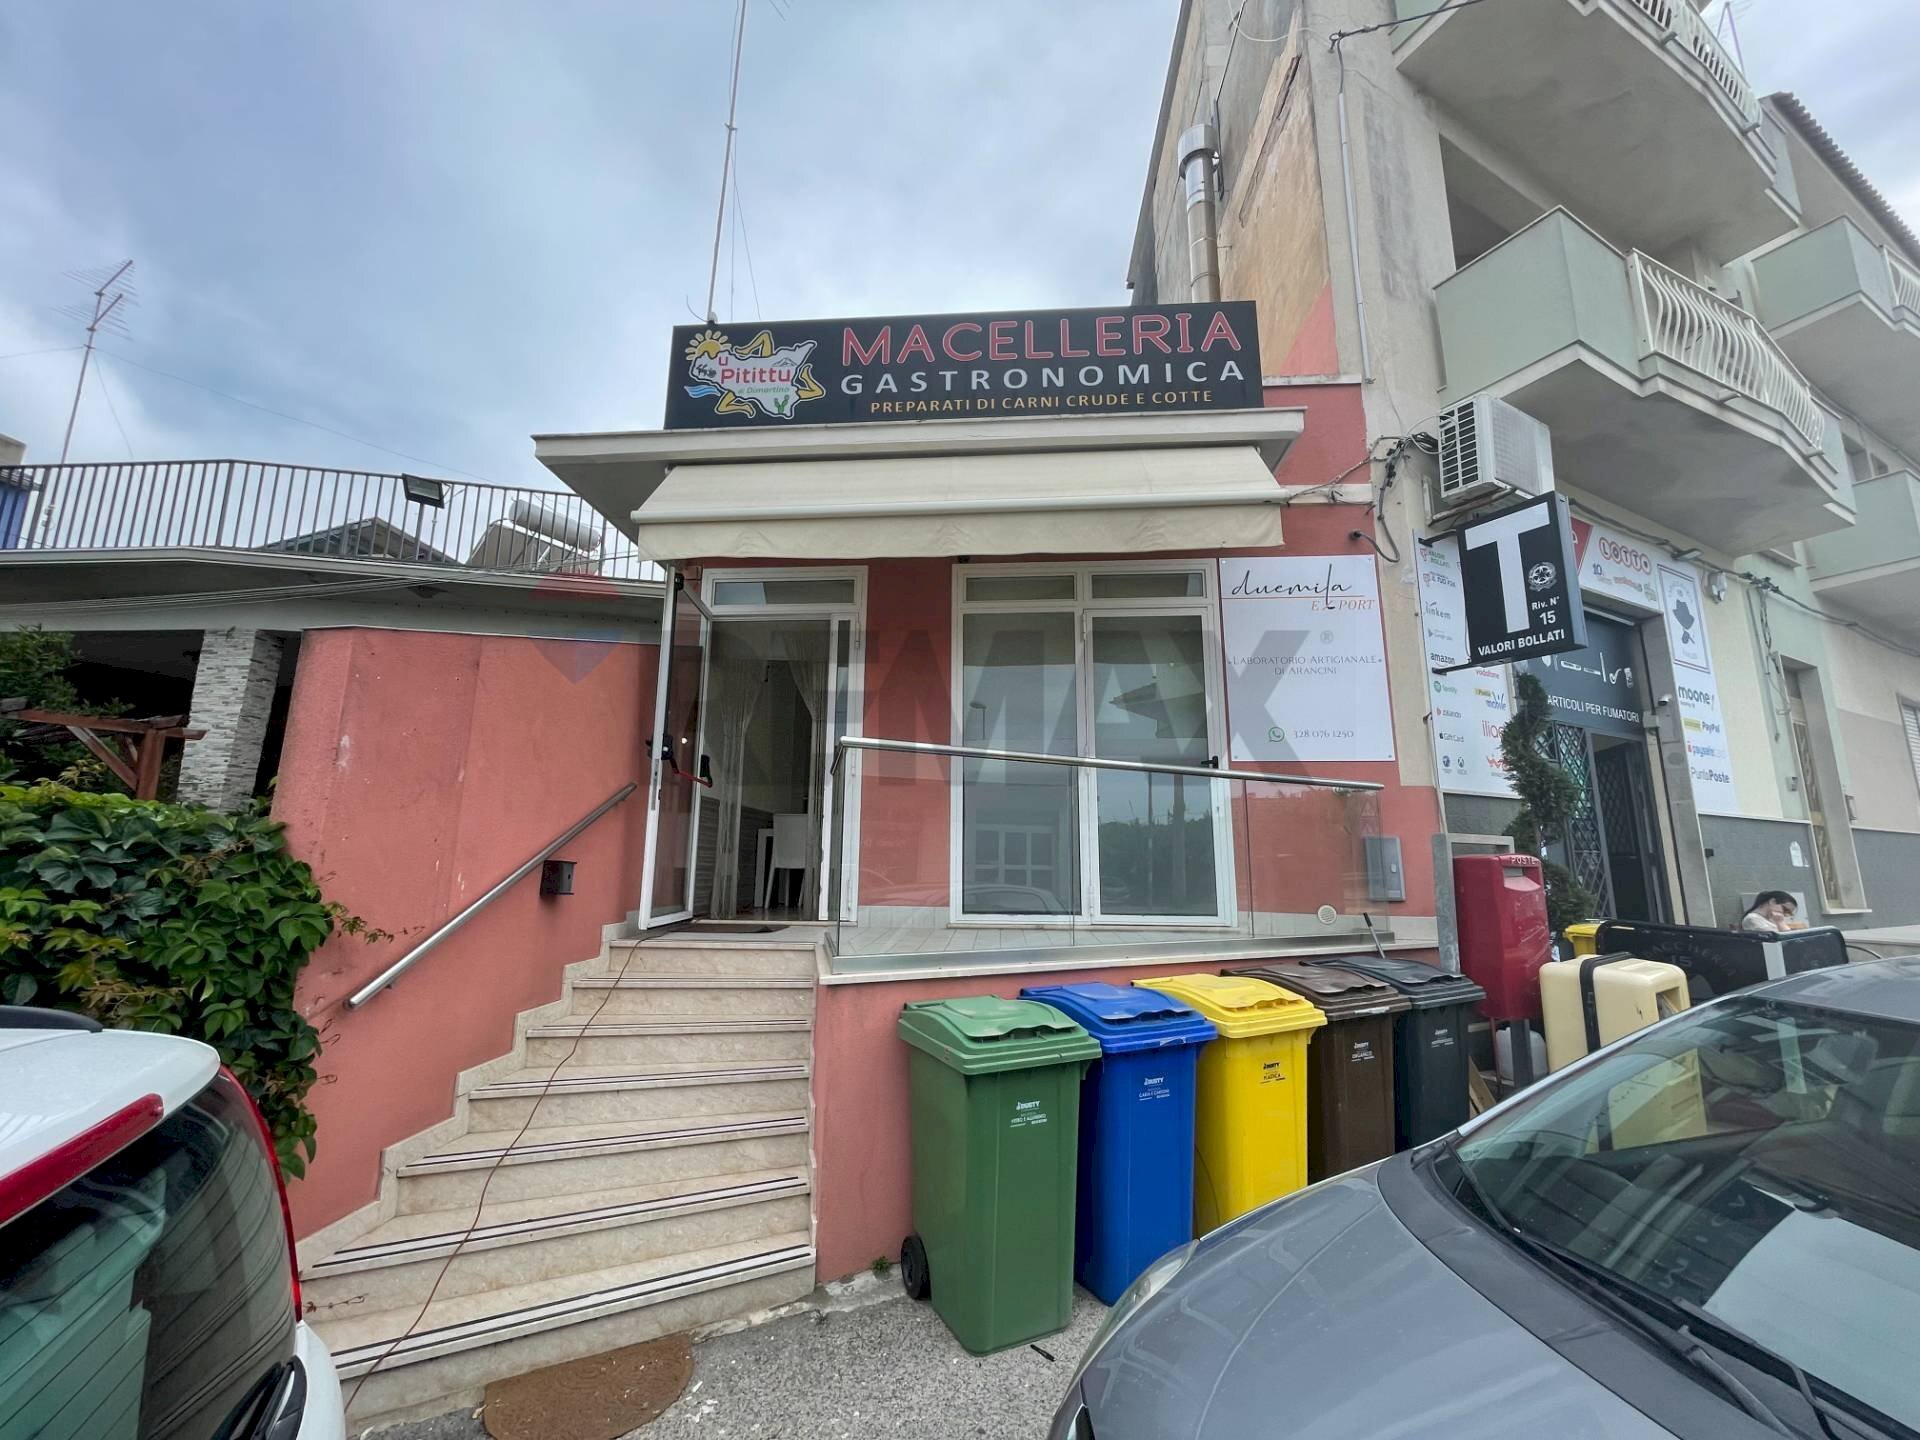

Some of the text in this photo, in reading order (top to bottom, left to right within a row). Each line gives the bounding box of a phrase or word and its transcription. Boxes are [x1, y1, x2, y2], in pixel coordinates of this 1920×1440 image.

[842, 311, 1242, 367] MACELLERIA
[720, 367, 791, 384] Pitittu
[840, 360, 1244, 395] GASTRONOMICA
[746, 385, 790, 395] Dimartino
[870, 390, 1213, 414] PREPARATI DI CARNI CRUDE E COTTE
[1599, 537, 1651, 576] LOTTO
[1231, 563, 1352, 610] duemila
[1531, 601, 1548, 611] Riv.
[1539, 610, 1556, 625] 15
[1477, 628, 1565, 657] VALORI BOLLATI
[1233, 655, 1377, 665] LABORATORIO ARTIGIANALE
[1430, 652, 1455, 664] amazon
[1288, 667, 1337, 675] ARANCINI
[1547, 694, 1640, 723] ARTICOLI PER FUMATORI
[1482, 720, 1504, 739] ilia
